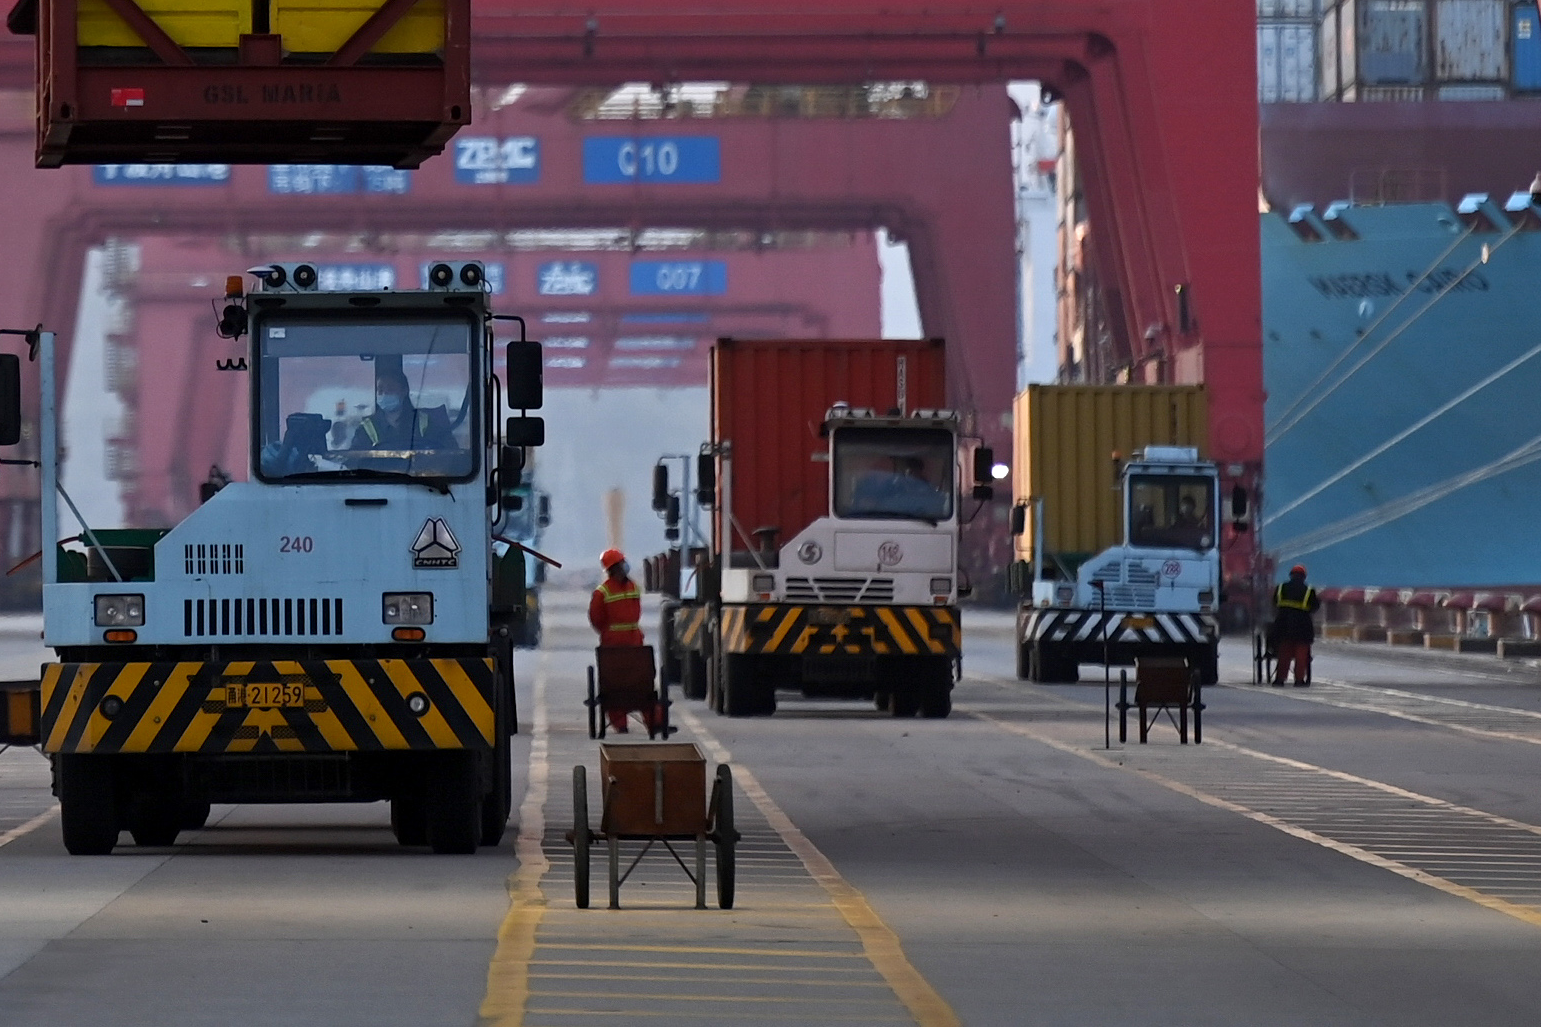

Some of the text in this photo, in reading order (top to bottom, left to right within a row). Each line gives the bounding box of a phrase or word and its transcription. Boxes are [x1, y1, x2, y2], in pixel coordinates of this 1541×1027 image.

[203, 82, 341, 105] GSL MARIA
[279, 535, 314, 554] 240
